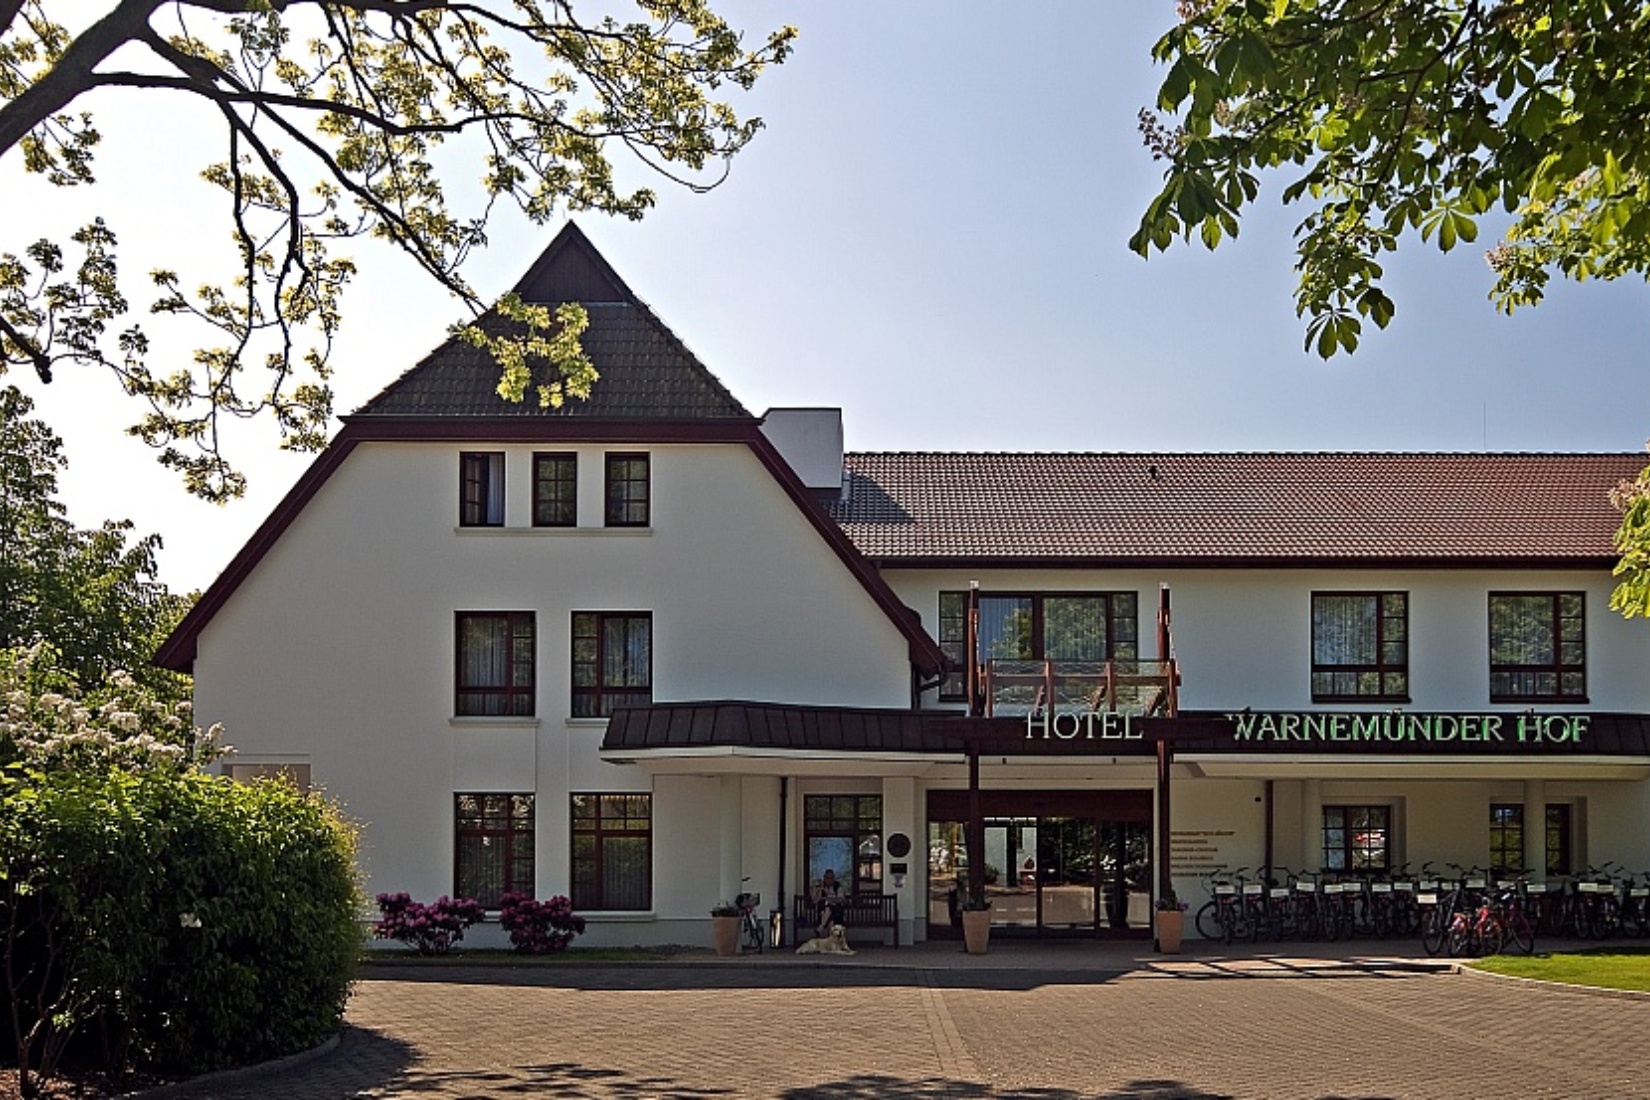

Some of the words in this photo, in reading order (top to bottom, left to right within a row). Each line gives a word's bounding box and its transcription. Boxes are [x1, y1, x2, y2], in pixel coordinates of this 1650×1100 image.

[1025, 711, 1143, 739] HOTEL
[1224, 708, 1504, 741] WARNEMÜNDER
[1516, 715, 1590, 742] HOF
